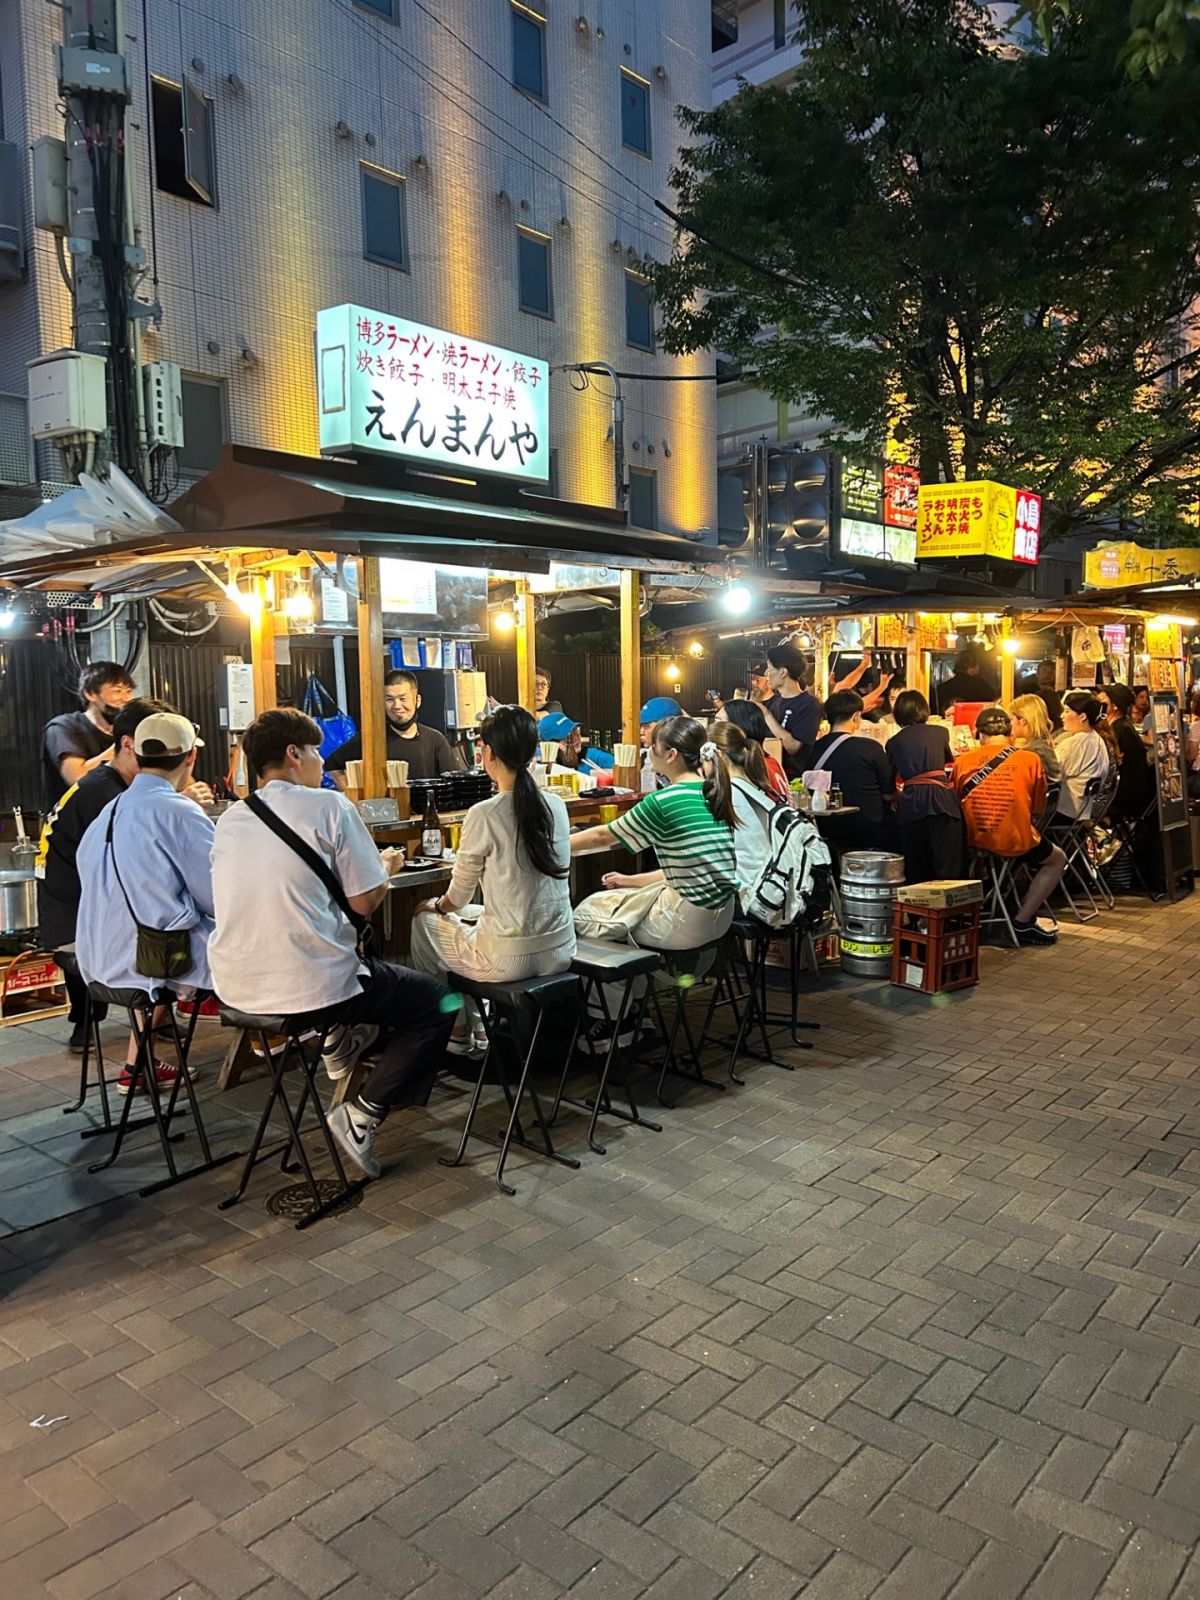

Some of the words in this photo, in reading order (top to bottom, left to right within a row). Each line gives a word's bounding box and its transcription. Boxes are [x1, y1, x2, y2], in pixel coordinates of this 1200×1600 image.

[364, 389, 540, 466] えんまんや
[921, 500, 933, 544] ラーメン
[933, 499, 945, 535] おでん
[946, 498, 958, 535] 明太子
[958, 497, 971, 535] 炭火焼
[972, 496, 983, 520] もつ
[843, 942, 858, 951] キリン
[873, 945, 892, 953] レモン
